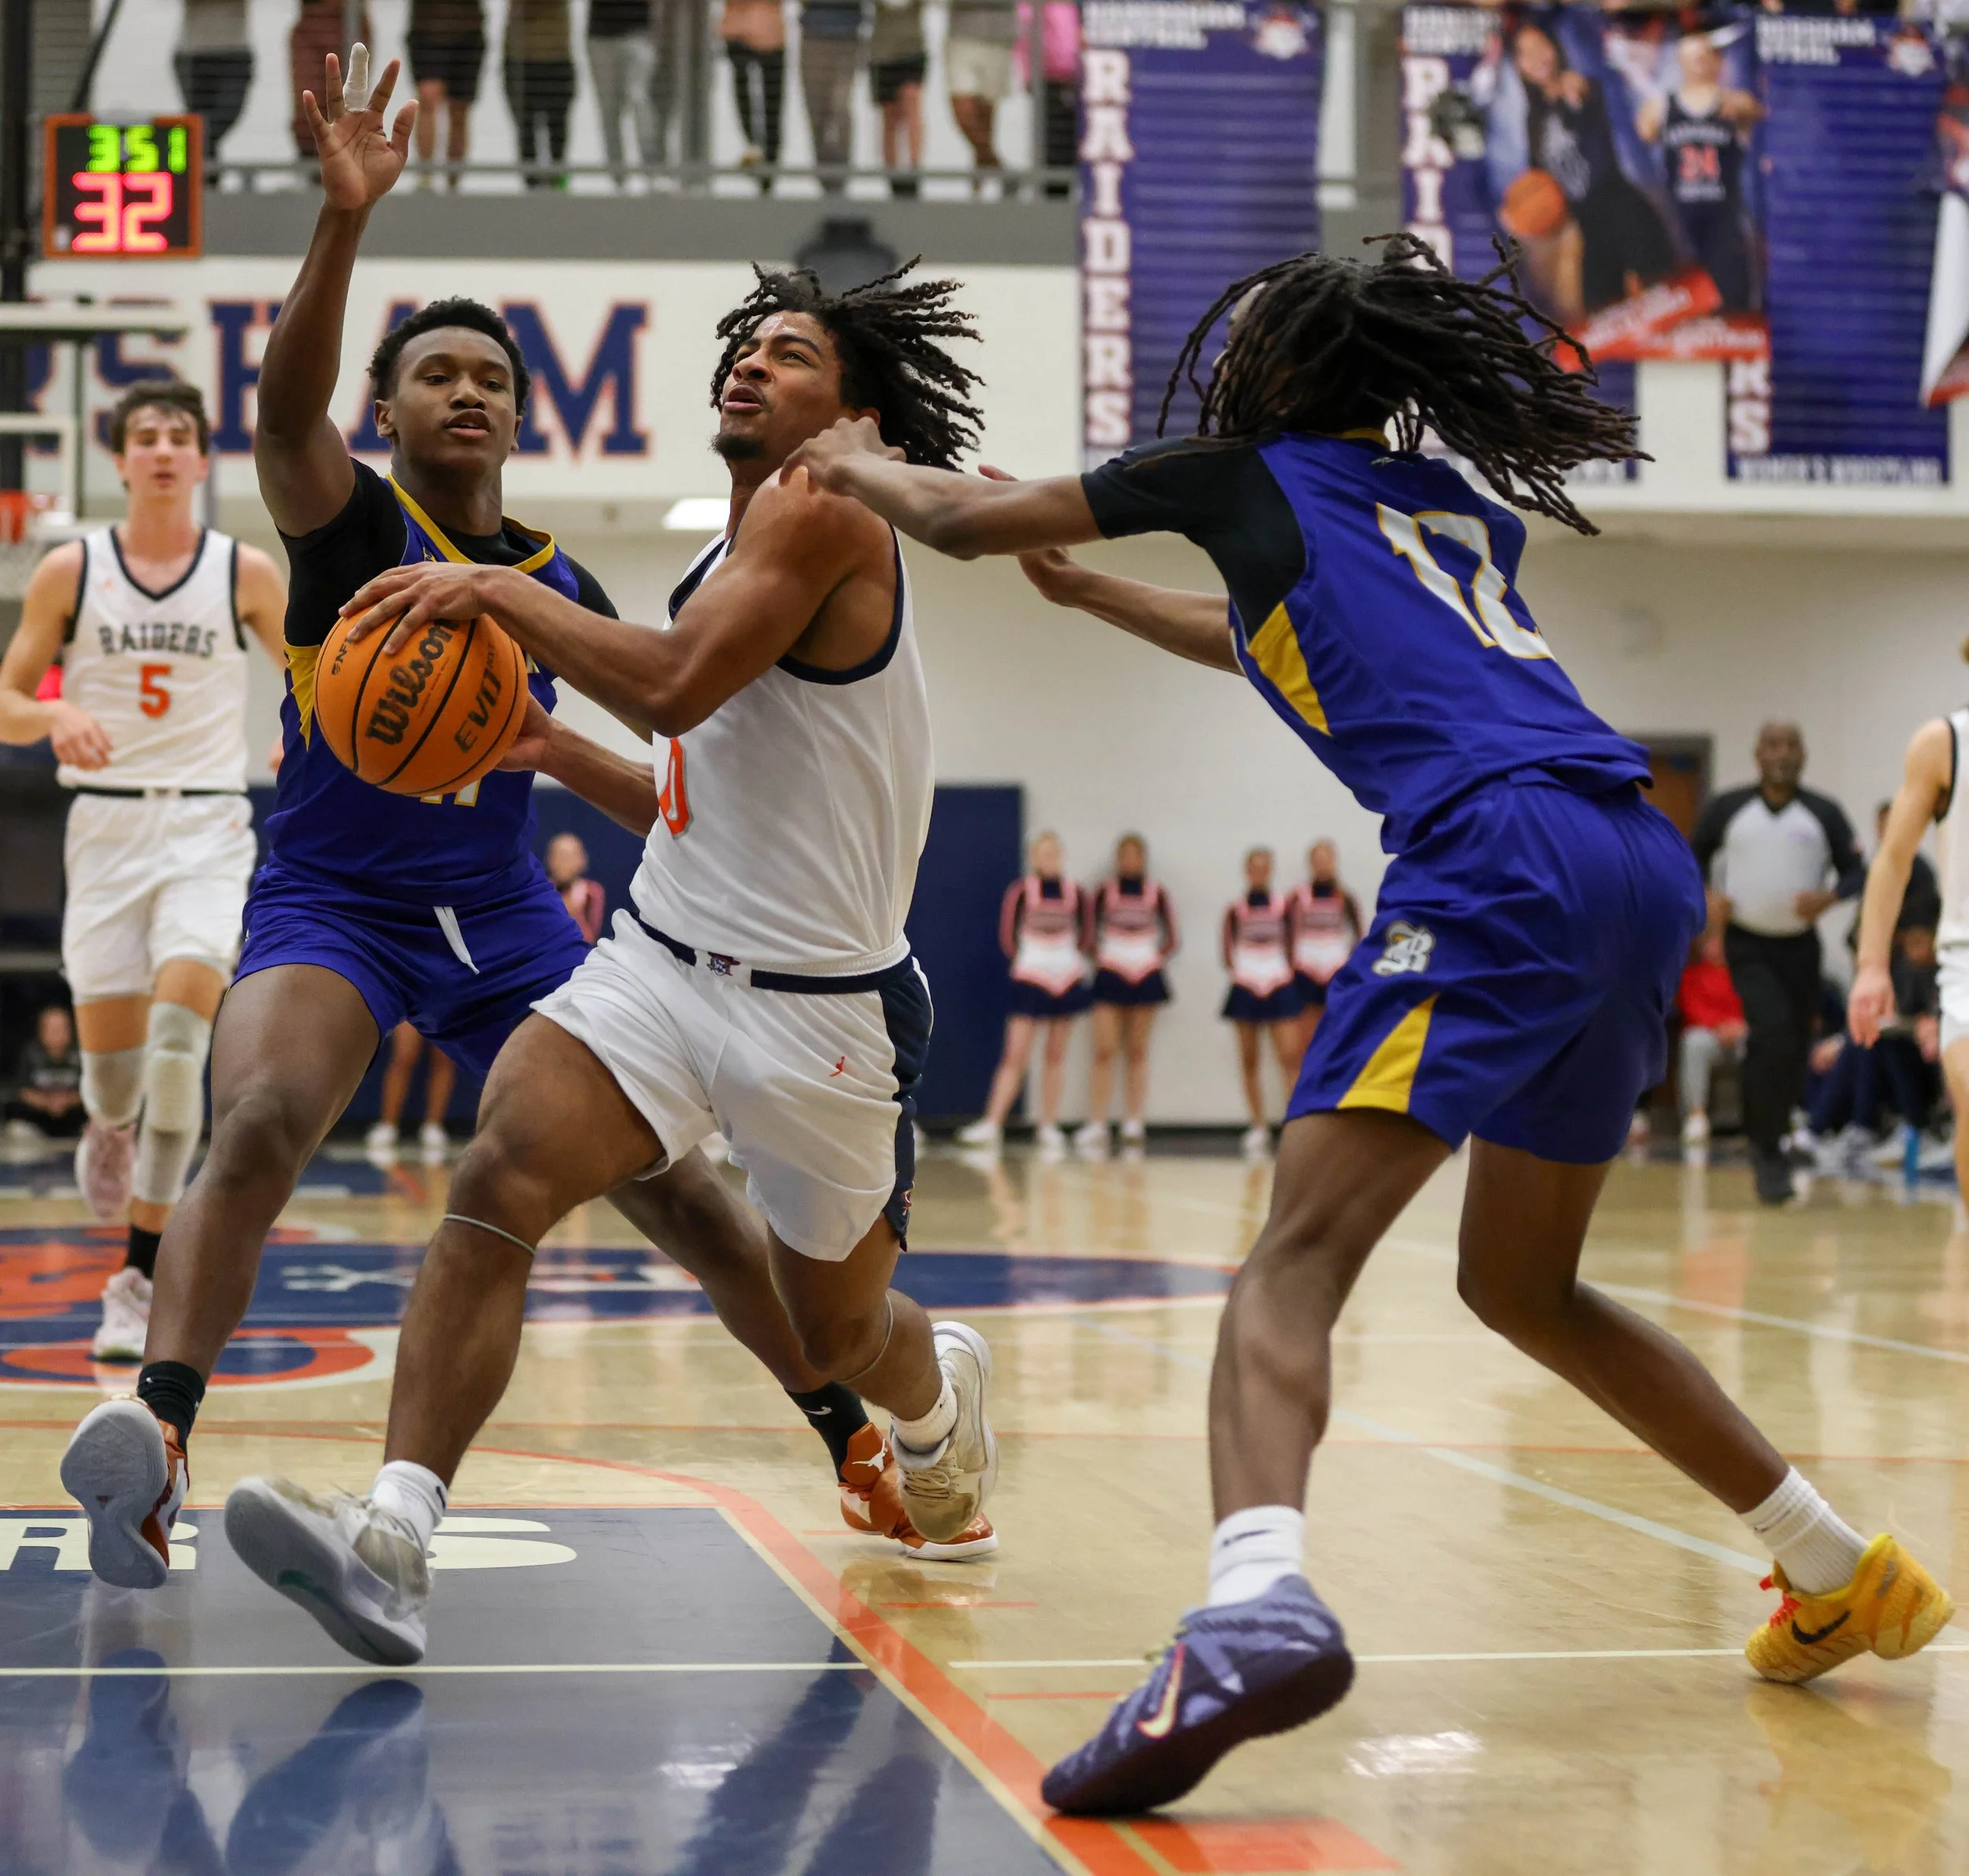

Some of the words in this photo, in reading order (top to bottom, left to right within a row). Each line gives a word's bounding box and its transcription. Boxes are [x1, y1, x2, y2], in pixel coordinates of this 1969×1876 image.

[72, 171, 173, 252] 32
[1081, 50, 1134, 446] RAIDERS
[1375, 501, 1556, 660] 12
[98, 621, 218, 658] RAIDERS
[139, 663, 172, 719] 5
[365, 617, 460, 745] Wilson
